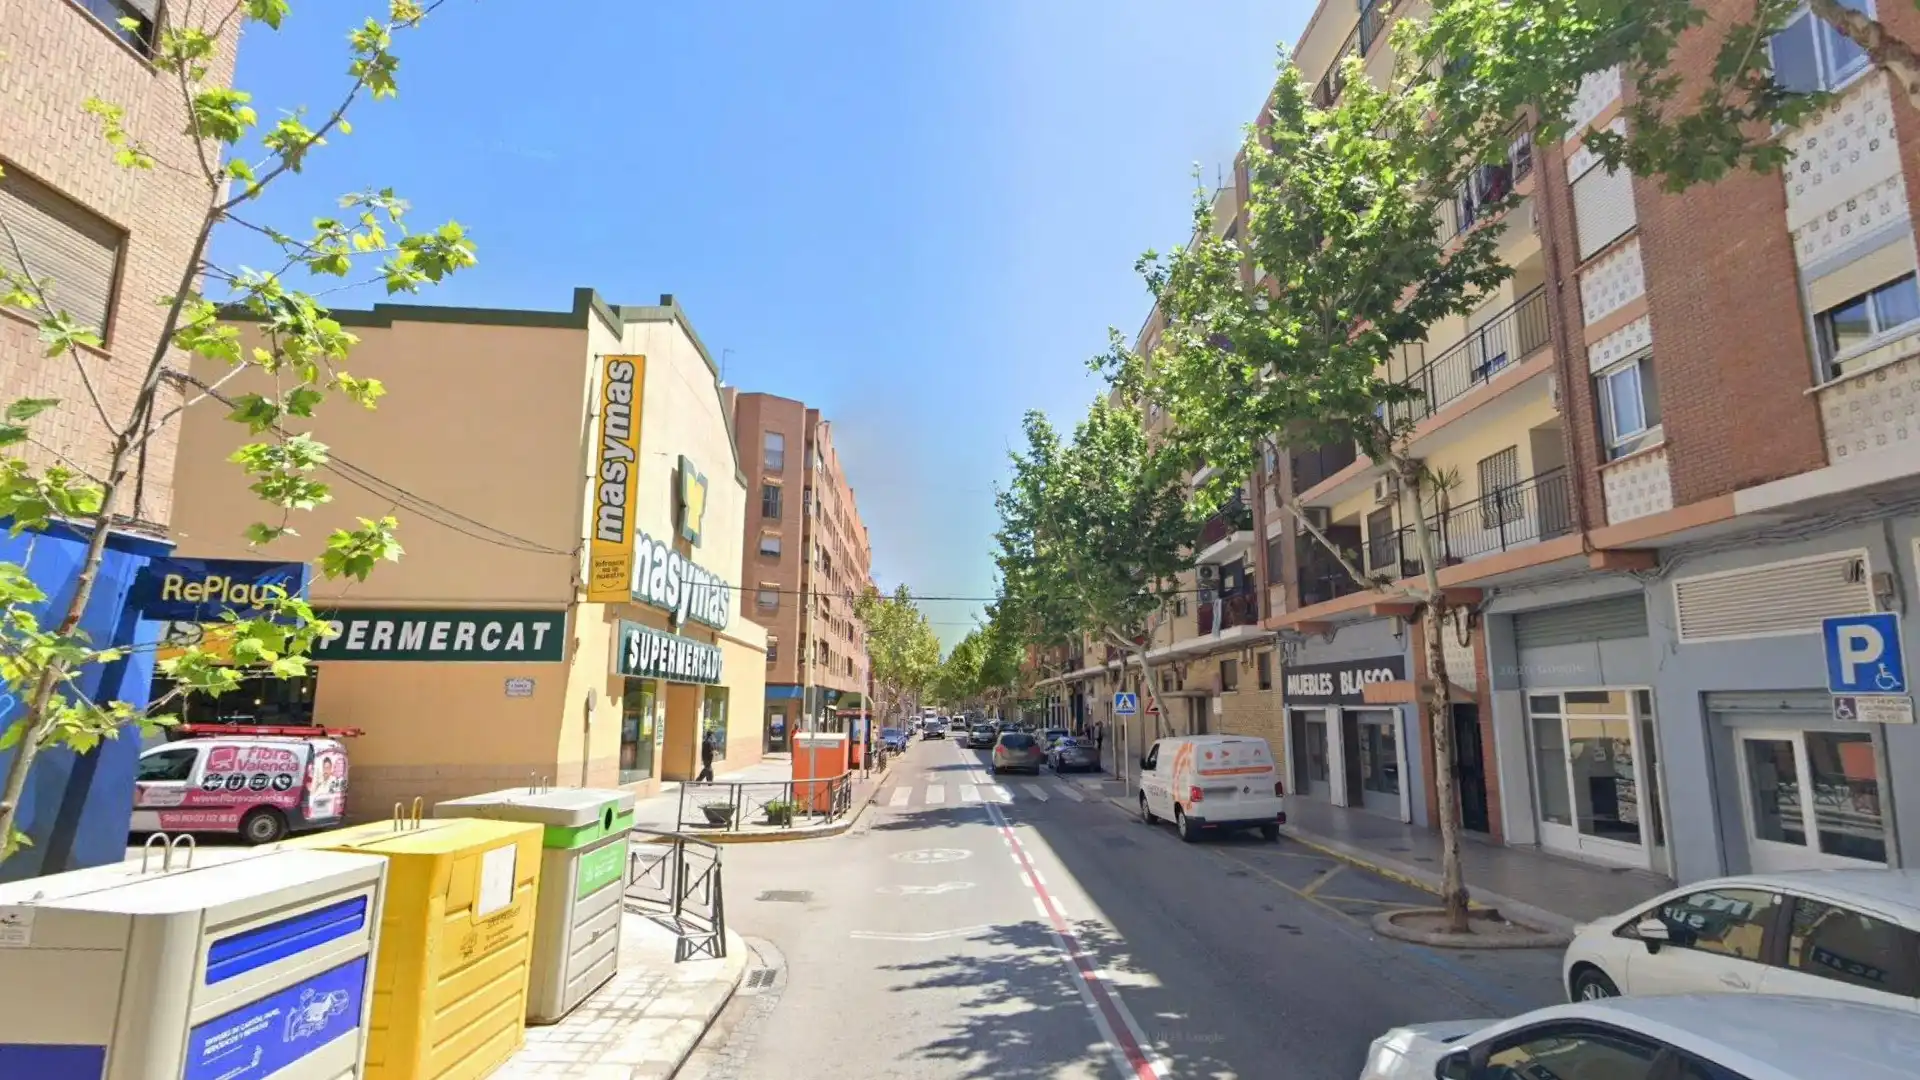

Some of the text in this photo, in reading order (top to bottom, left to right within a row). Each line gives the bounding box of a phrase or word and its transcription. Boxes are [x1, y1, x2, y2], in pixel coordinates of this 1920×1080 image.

[597, 359, 635, 544] masymas
[319, 620, 551, 651] PERMERCAT
[1836, 624, 1885, 685] P
[1287, 673, 1334, 696] MUEBLES
[238, 759, 299, 772] Valencia
